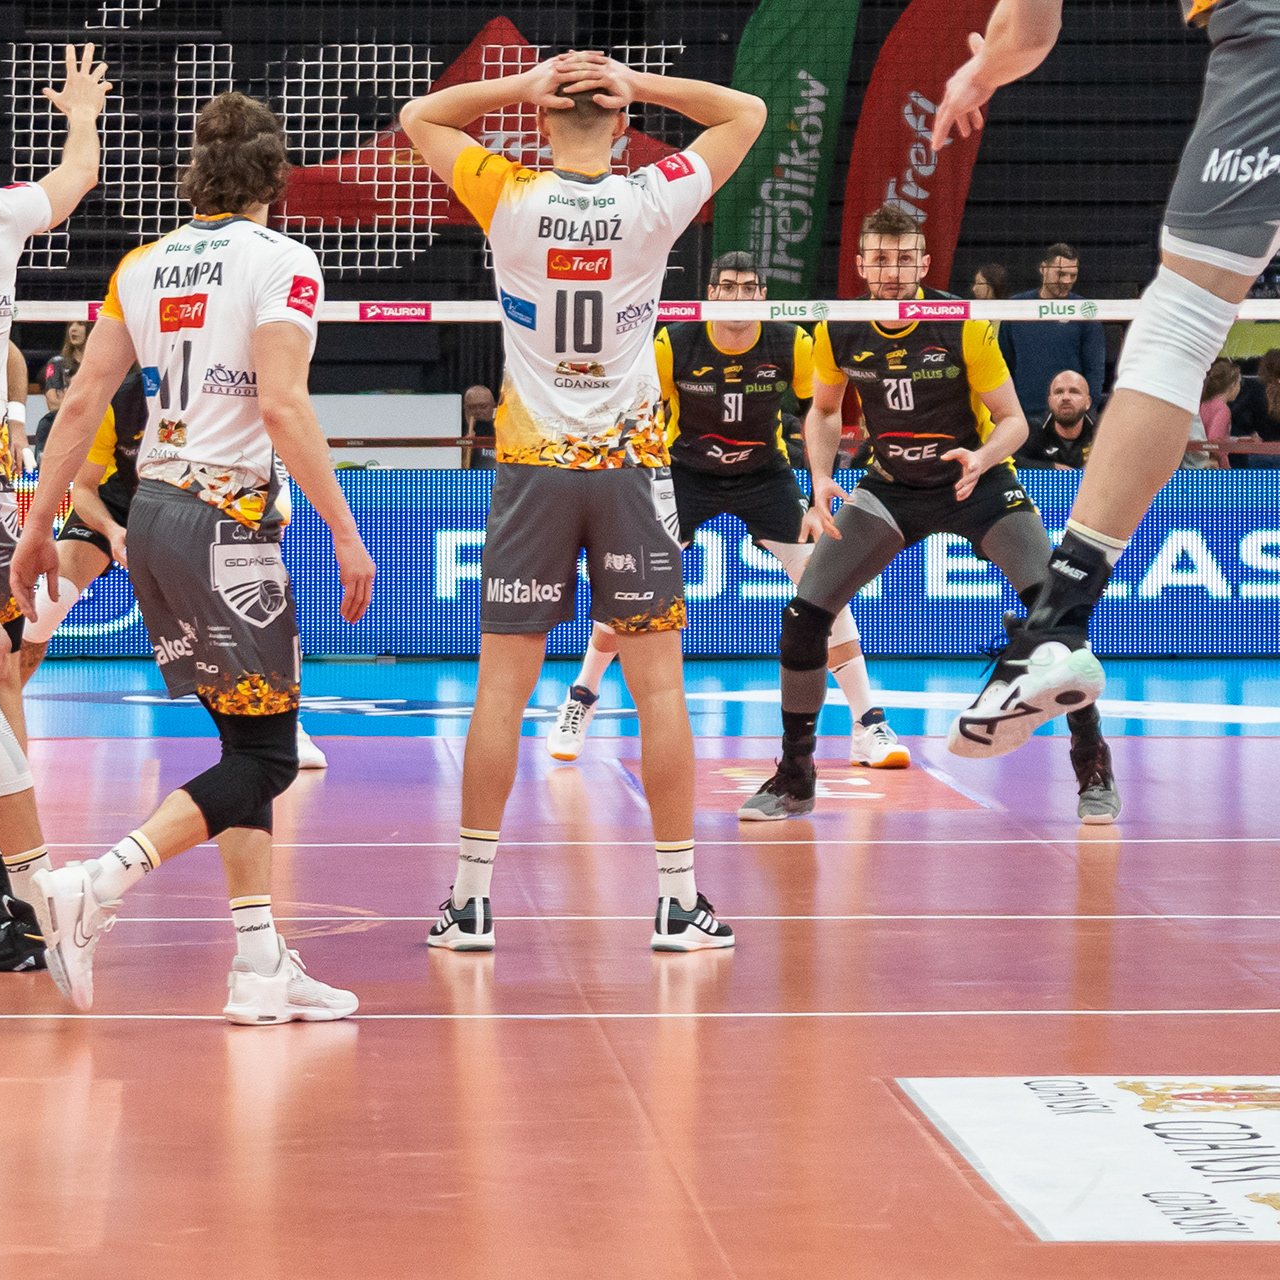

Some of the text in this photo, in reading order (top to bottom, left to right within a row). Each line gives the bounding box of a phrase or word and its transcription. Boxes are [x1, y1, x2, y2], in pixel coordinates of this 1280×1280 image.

[548, 194, 616, 208] plus liga
[538, 214, 623, 246] BOŁĄDŹ
[165, 242, 191, 255] plus
[572, 256, 609, 274] Trefl
[154, 262, 223, 290] KAMPA
[382, 306, 426, 316] TAURON
[658, 306, 696, 316] AURON
[770, 302, 807, 318] plus
[921, 306, 965, 316] TAURON
[1039, 301, 1075, 318] plus
[554, 290, 603, 354] 10
[923, 353, 946, 363] PGE
[553, 375, 612, 389] GDAŃSK
[912, 368, 943, 382] plus
[745, 382, 773, 394] plus
[883, 378, 915, 411] 20
[723, 393, 743, 422] 91
[706, 444, 754, 464] PGE
[888, 442, 939, 461] PGE
[486, 577, 563, 604] Mistakos
